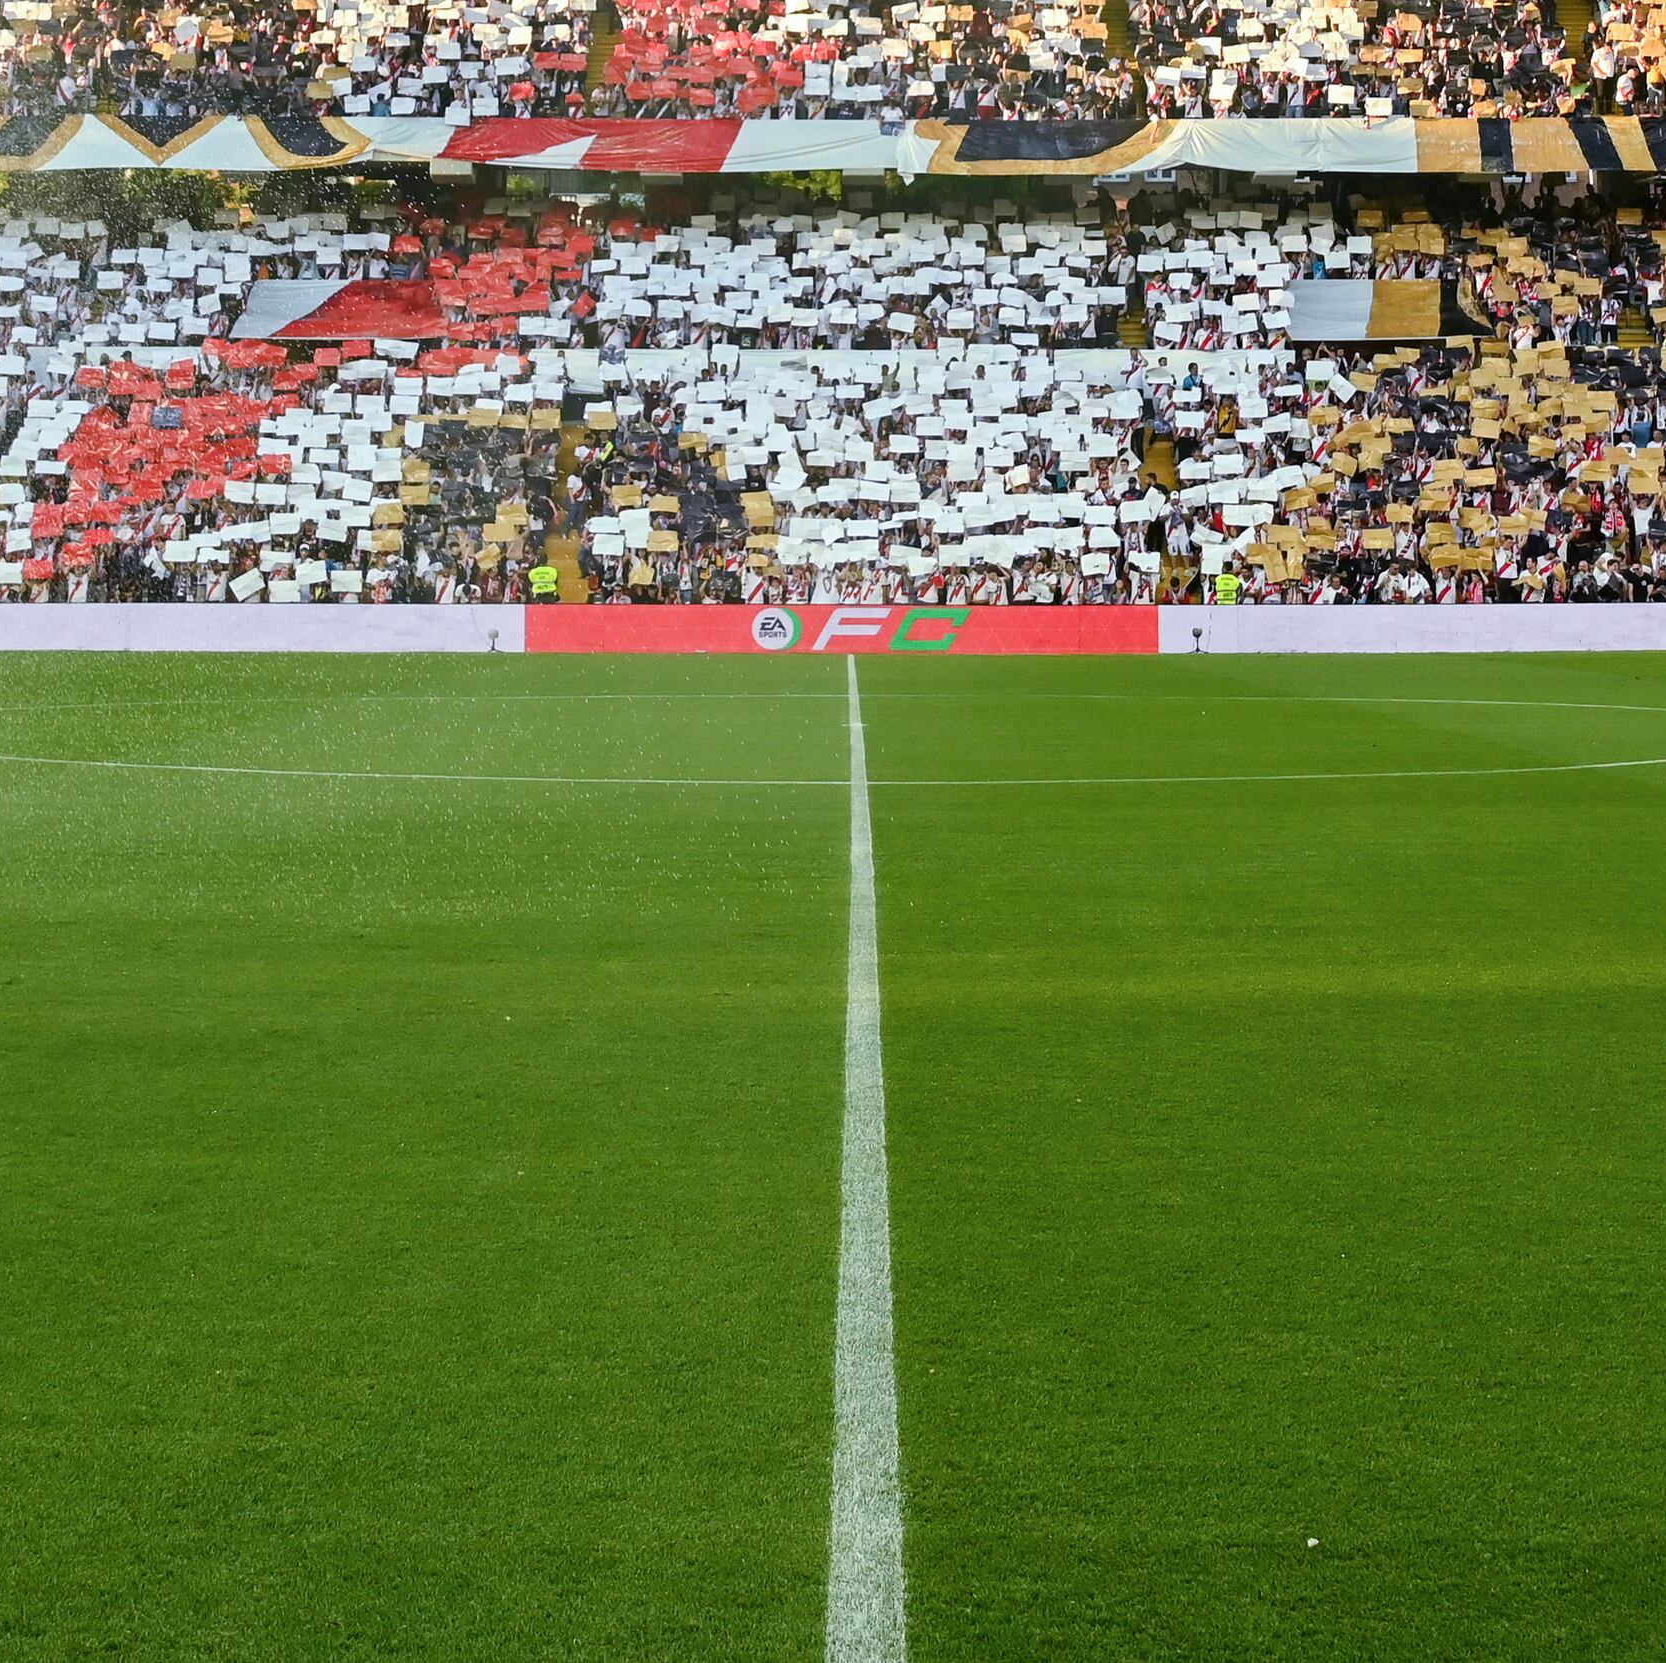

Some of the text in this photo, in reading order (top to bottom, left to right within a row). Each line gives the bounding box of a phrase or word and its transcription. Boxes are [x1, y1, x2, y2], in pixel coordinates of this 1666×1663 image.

[759, 616, 786, 631] EA
[812, 608, 972, 651] FC
[758, 631, 788, 639] SPORTS
